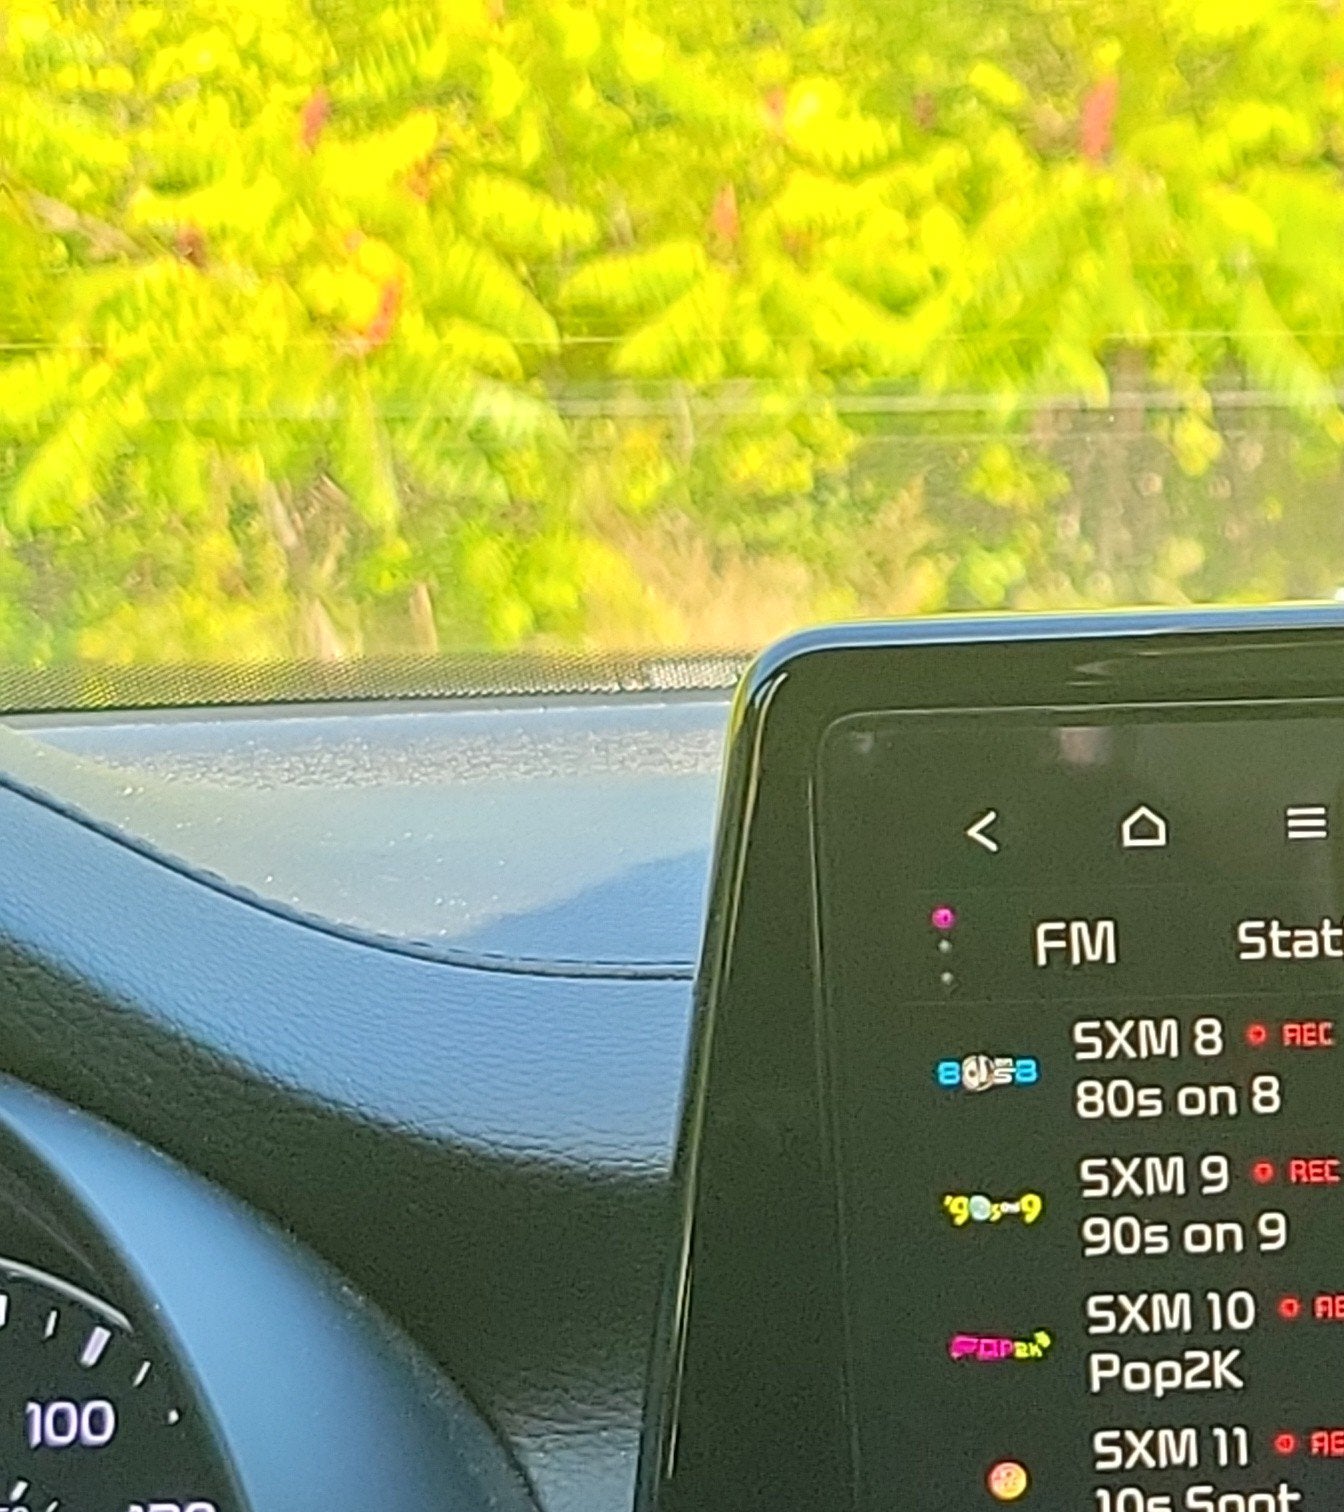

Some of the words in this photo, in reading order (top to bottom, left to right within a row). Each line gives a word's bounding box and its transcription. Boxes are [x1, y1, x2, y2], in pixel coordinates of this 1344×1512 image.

[1036, 920, 1116, 966] FM
[1074, 1018, 1179, 1060] SXM
[1194, 1018, 1223, 1056] 8
[1283, 1022, 1332, 1046] REC
[1076, 1079, 1163, 1118] 80s
[1177, 1085, 1237, 1116] on
[1252, 1075, 1281, 1114] 8
[1080, 1156, 1185, 1198] SXM
[1200, 1155, 1229, 1194] 9
[1289, 1159, 1340, 1183] REC
[1083, 1216, 1169, 1256] 90s
[1184, 1222, 1244, 1253] on
[1258, 1212, 1286, 1251] 9
[1087, 1292, 1192, 1334] SXM
[1207, 1291, 1255, 1331] 10
[1090, 1349, 1244, 1398] Pop2K
[26, 1400, 115, 1446] 100
[1093, 1428, 1198, 1470] SXM
[1213, 1427, 1248, 1466] 11
